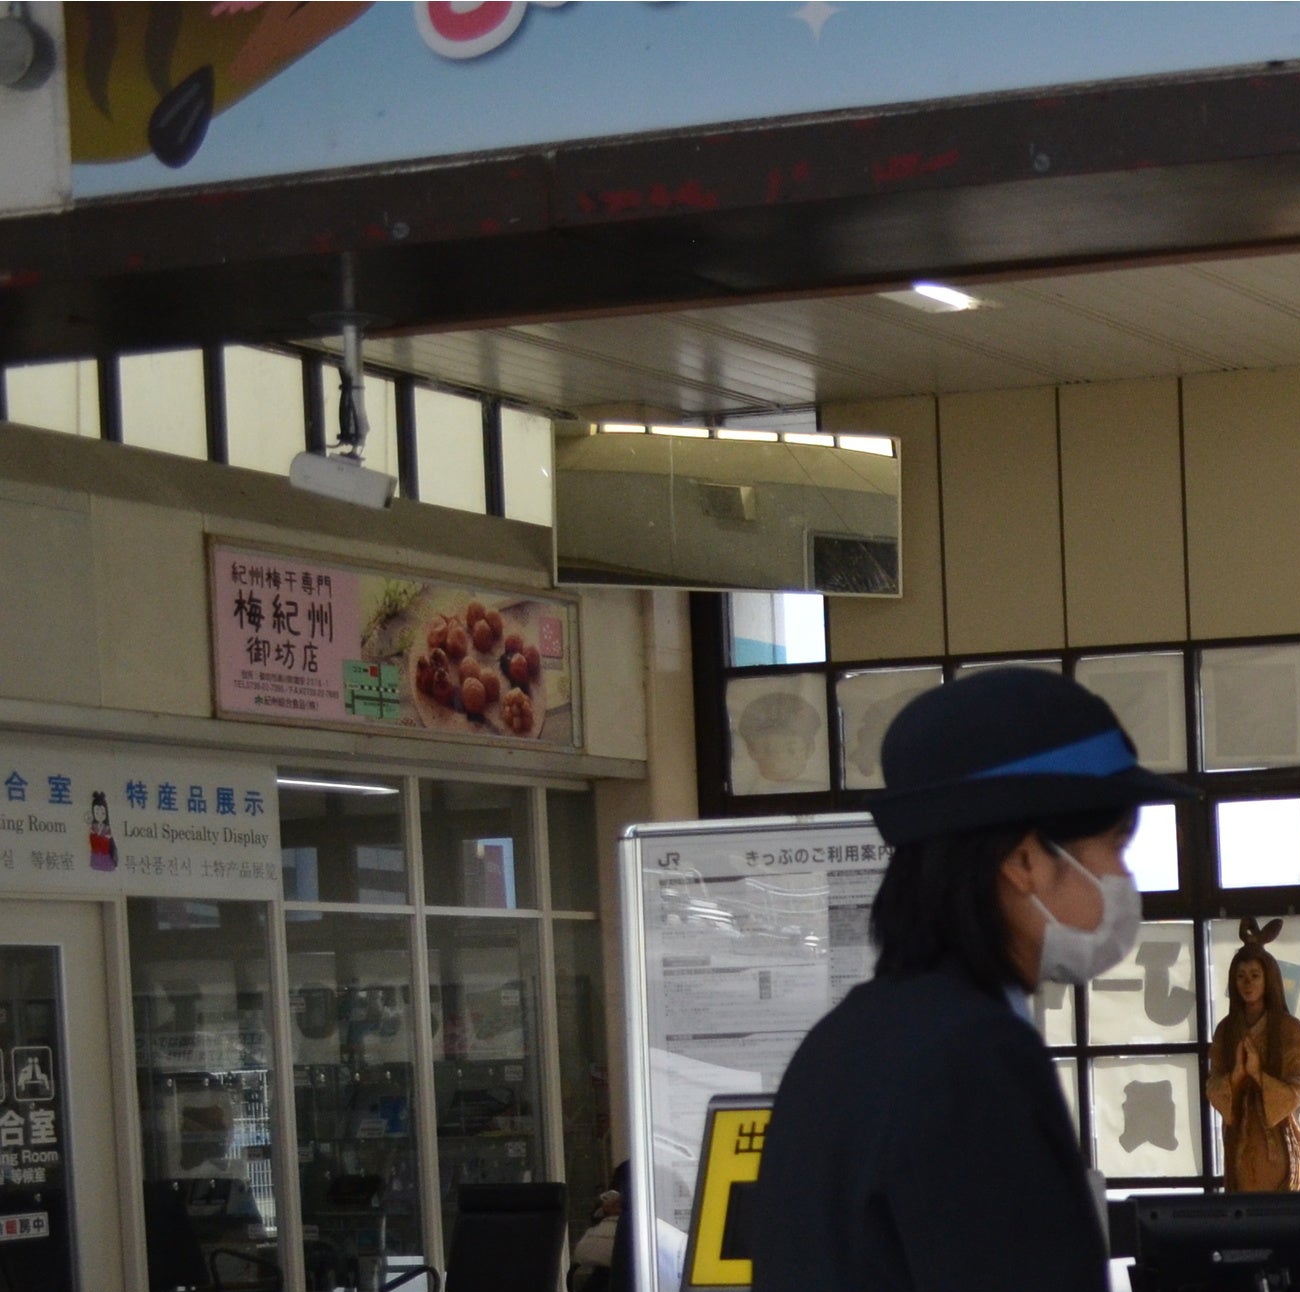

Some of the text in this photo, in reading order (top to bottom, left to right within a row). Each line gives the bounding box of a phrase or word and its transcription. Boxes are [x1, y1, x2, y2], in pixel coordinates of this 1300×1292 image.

[231, 561, 332, 598] 紀州梅干専門
[233, 589, 334, 643] 梅紀州
[247, 637, 319, 673] 御坊店
[125, 779, 265, 816] 特産品展示
[28, 815, 67, 833] Room
[123, 821, 269, 848] Local Specialty Display
[658, 853, 680, 867] JR
[745, 845, 893, 866] きっぷのご利用案内
[22, 1150, 59, 1164] Room
